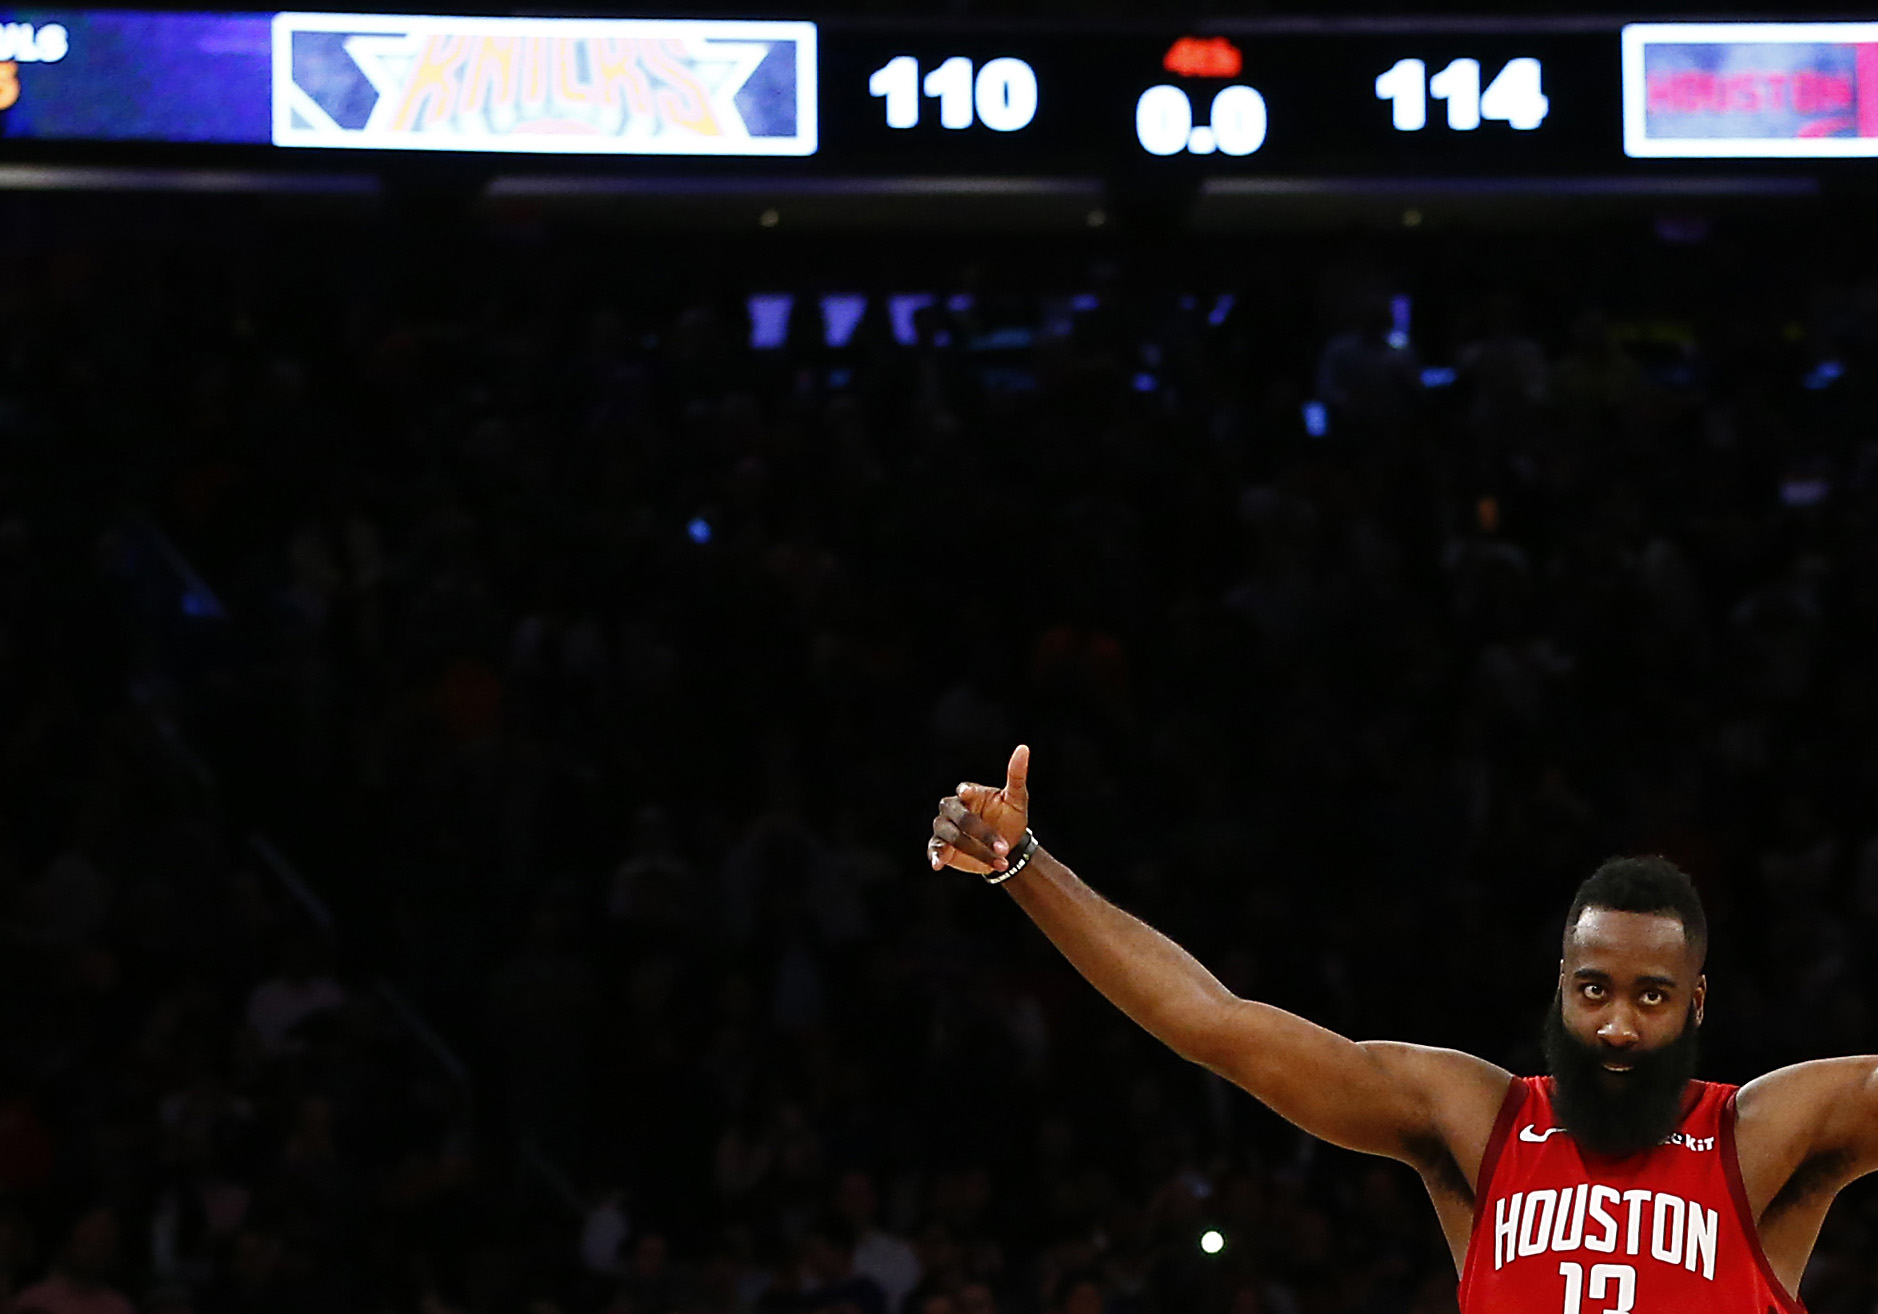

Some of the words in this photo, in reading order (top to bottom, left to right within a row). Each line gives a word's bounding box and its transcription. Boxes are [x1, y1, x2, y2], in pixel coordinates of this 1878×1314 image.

[869, 56, 1037, 131] 110
[1136, 84, 1267, 156] 0.0
[1376, 58, 1548, 131] 114
[1494, 1184, 1718, 1281] HOUSTON
